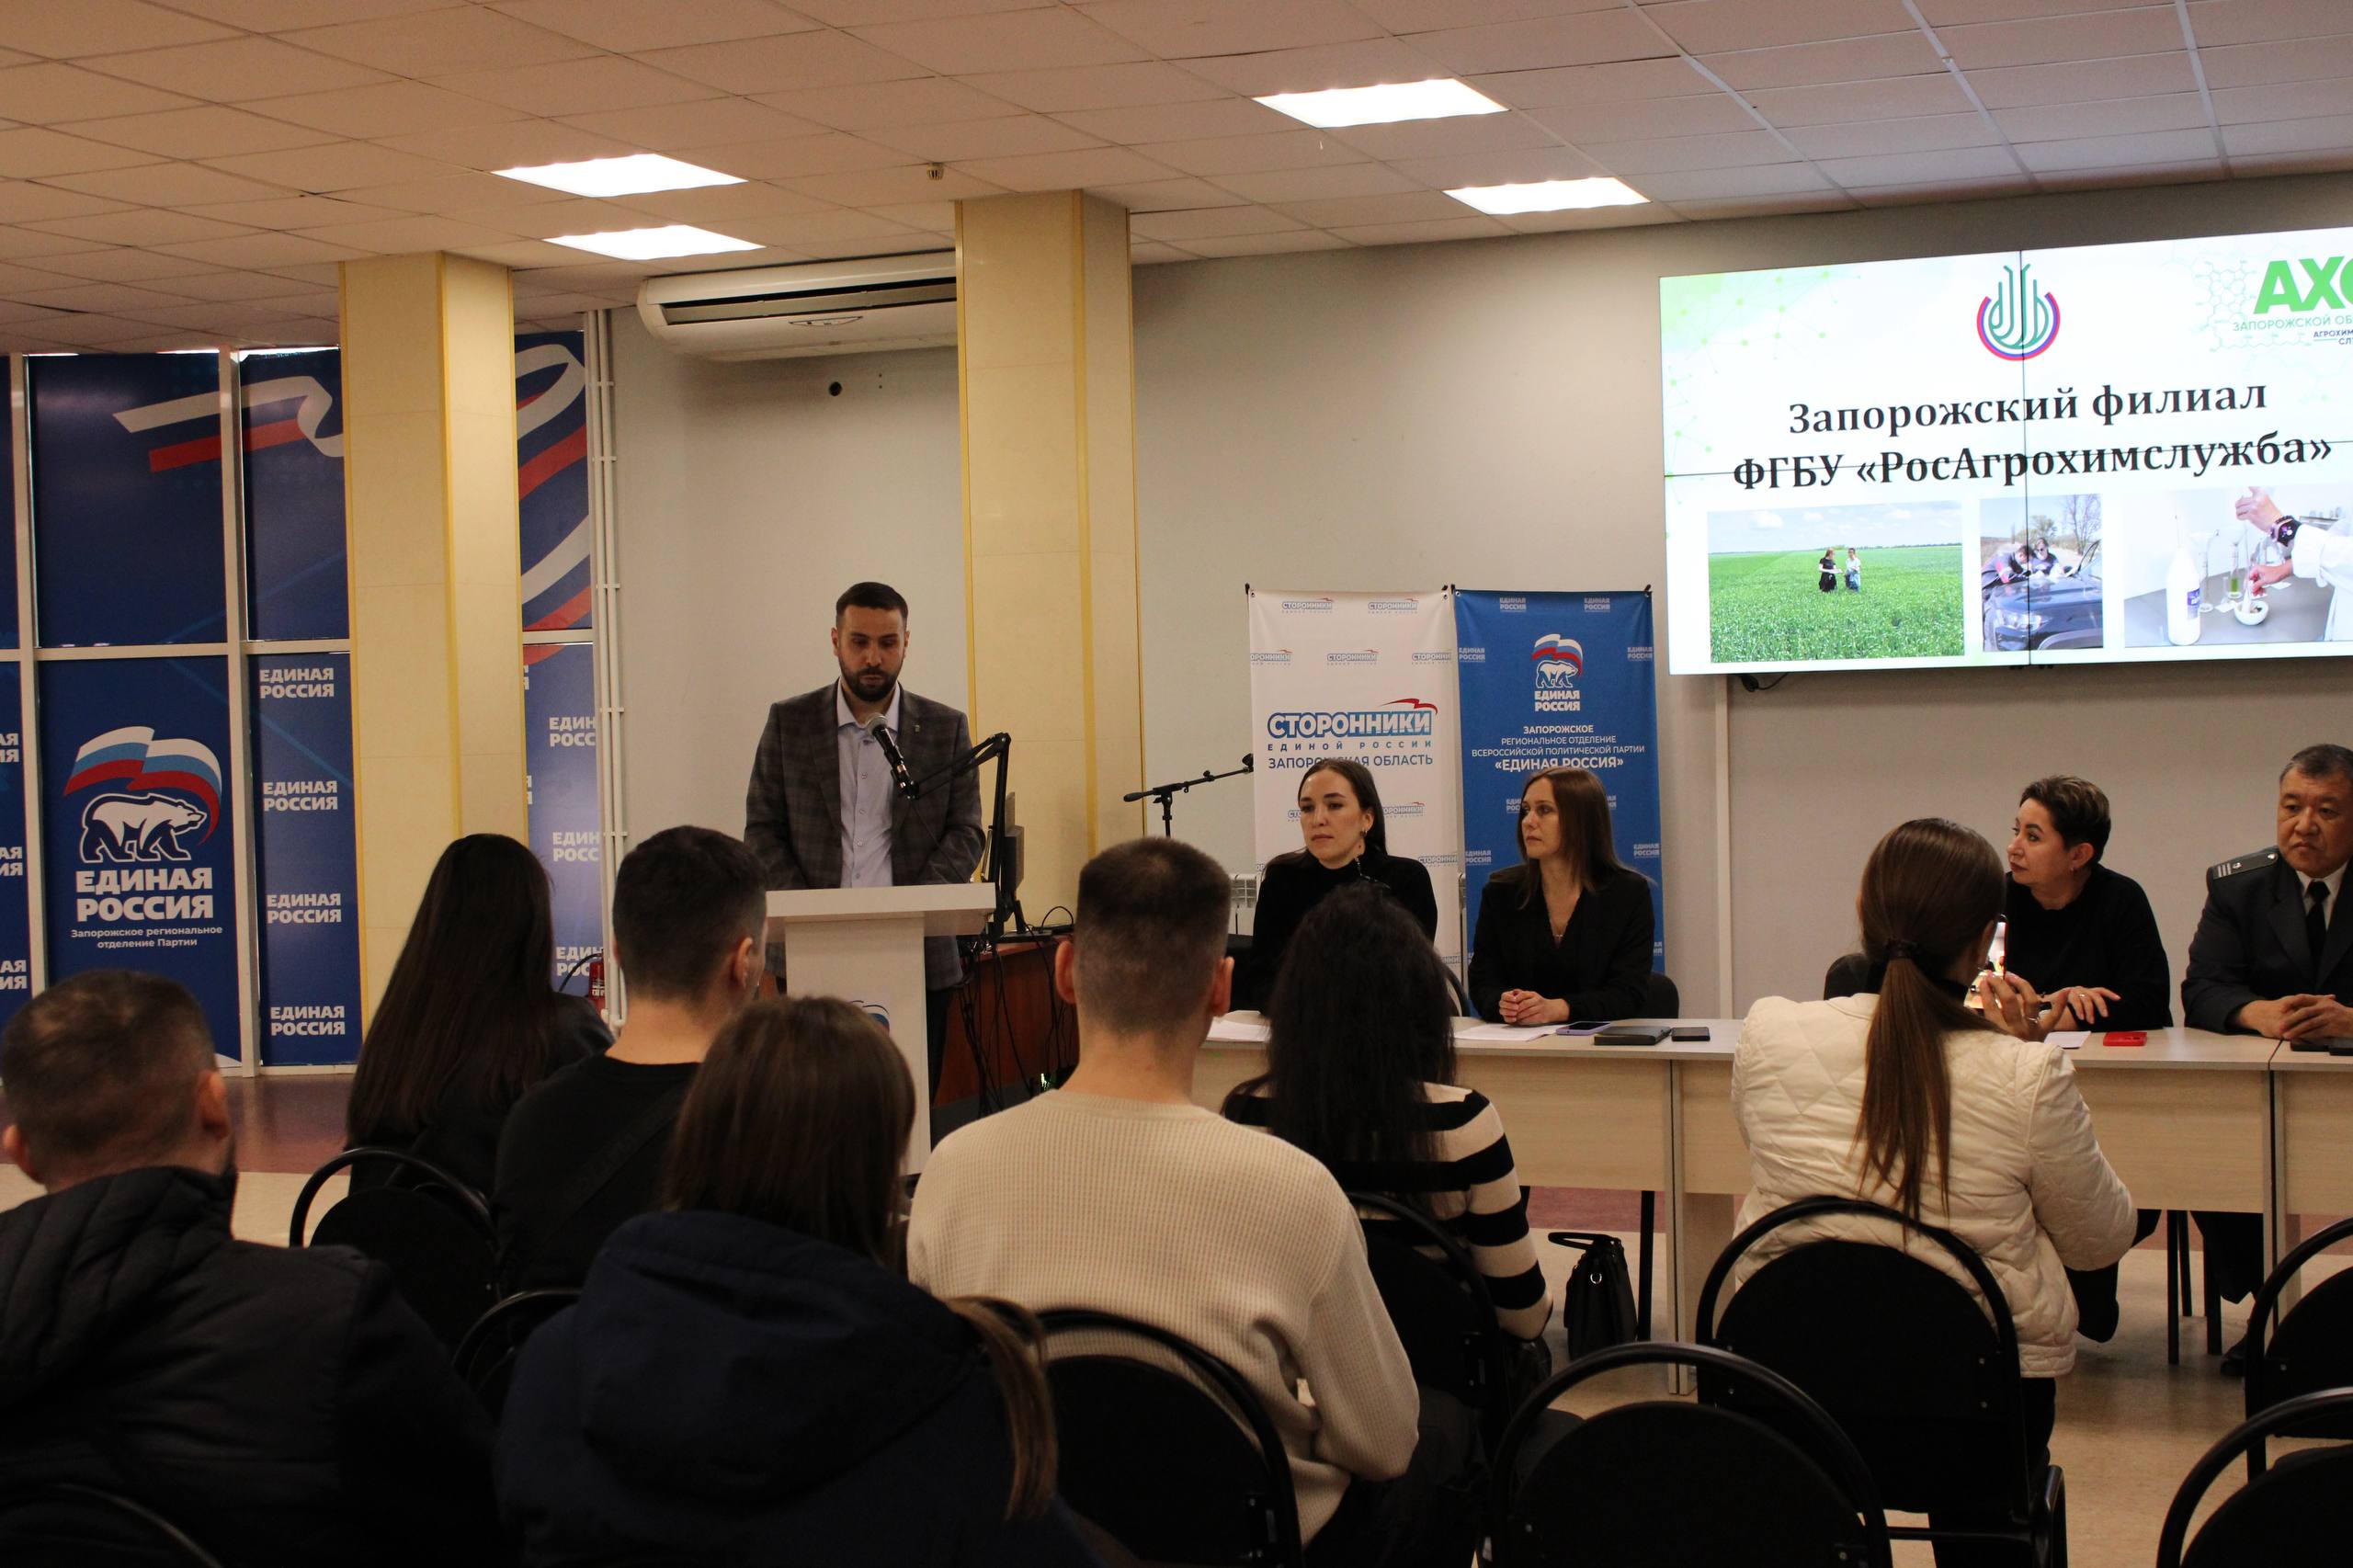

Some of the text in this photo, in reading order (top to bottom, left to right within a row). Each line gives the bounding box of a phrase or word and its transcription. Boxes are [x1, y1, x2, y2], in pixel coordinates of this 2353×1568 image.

[2233, 313, 2331, 332] ЗАПОРОЖСКОЙ
[1790, 384, 2267, 437] Запорожский филиал
[1733, 430, 2332, 490] ФГБУ «РосАгрохимслужба»
[259, 667, 335, 684] ЕДИНАЯ
[259, 683, 335, 699] РОССИЯ
[1534, 690, 1580, 701] ЕДИНАЯ
[1535, 701, 1581, 712] РОССИЯ
[1267, 711, 1431, 738] СТОРОННИКИ
[1523, 724, 1594, 734] ЗАПОРОЖСКОЕ
[1267, 740, 1431, 752] ЕДИНОЙ РОССИИ
[1501, 735, 1617, 745] РЕГИОНАЛЬНОЕ ОТДЕЛЕНИЕ
[1472, 744, 1645, 756] ВСЕРОССИЙСКОЙ ПОЛИТИЧЕСКОЙ ПАРТИИ
[1373, 754, 1433, 767] ОБЛАСТЬ
[1495, 756, 1624, 772] «ЕДИНАЯ РОССИЯ»
[263, 780, 338, 796] ЕДИНАЯ
[263, 796, 338, 812] РОССИЯ
[75, 868, 213, 894] ЕДИНАЯ
[76, 895, 214, 922] РОССИЯ
[267, 892, 342, 909] ЕДИНАЯ
[267, 908, 342, 924] РОССИЯ
[71, 926, 223, 939] Запорожское региональное
[97, 938, 198, 949] отделение Партии
[270, 1006, 345, 1021] ЕДИНАЯ
[270, 1021, 346, 1036] РОССИЯ
